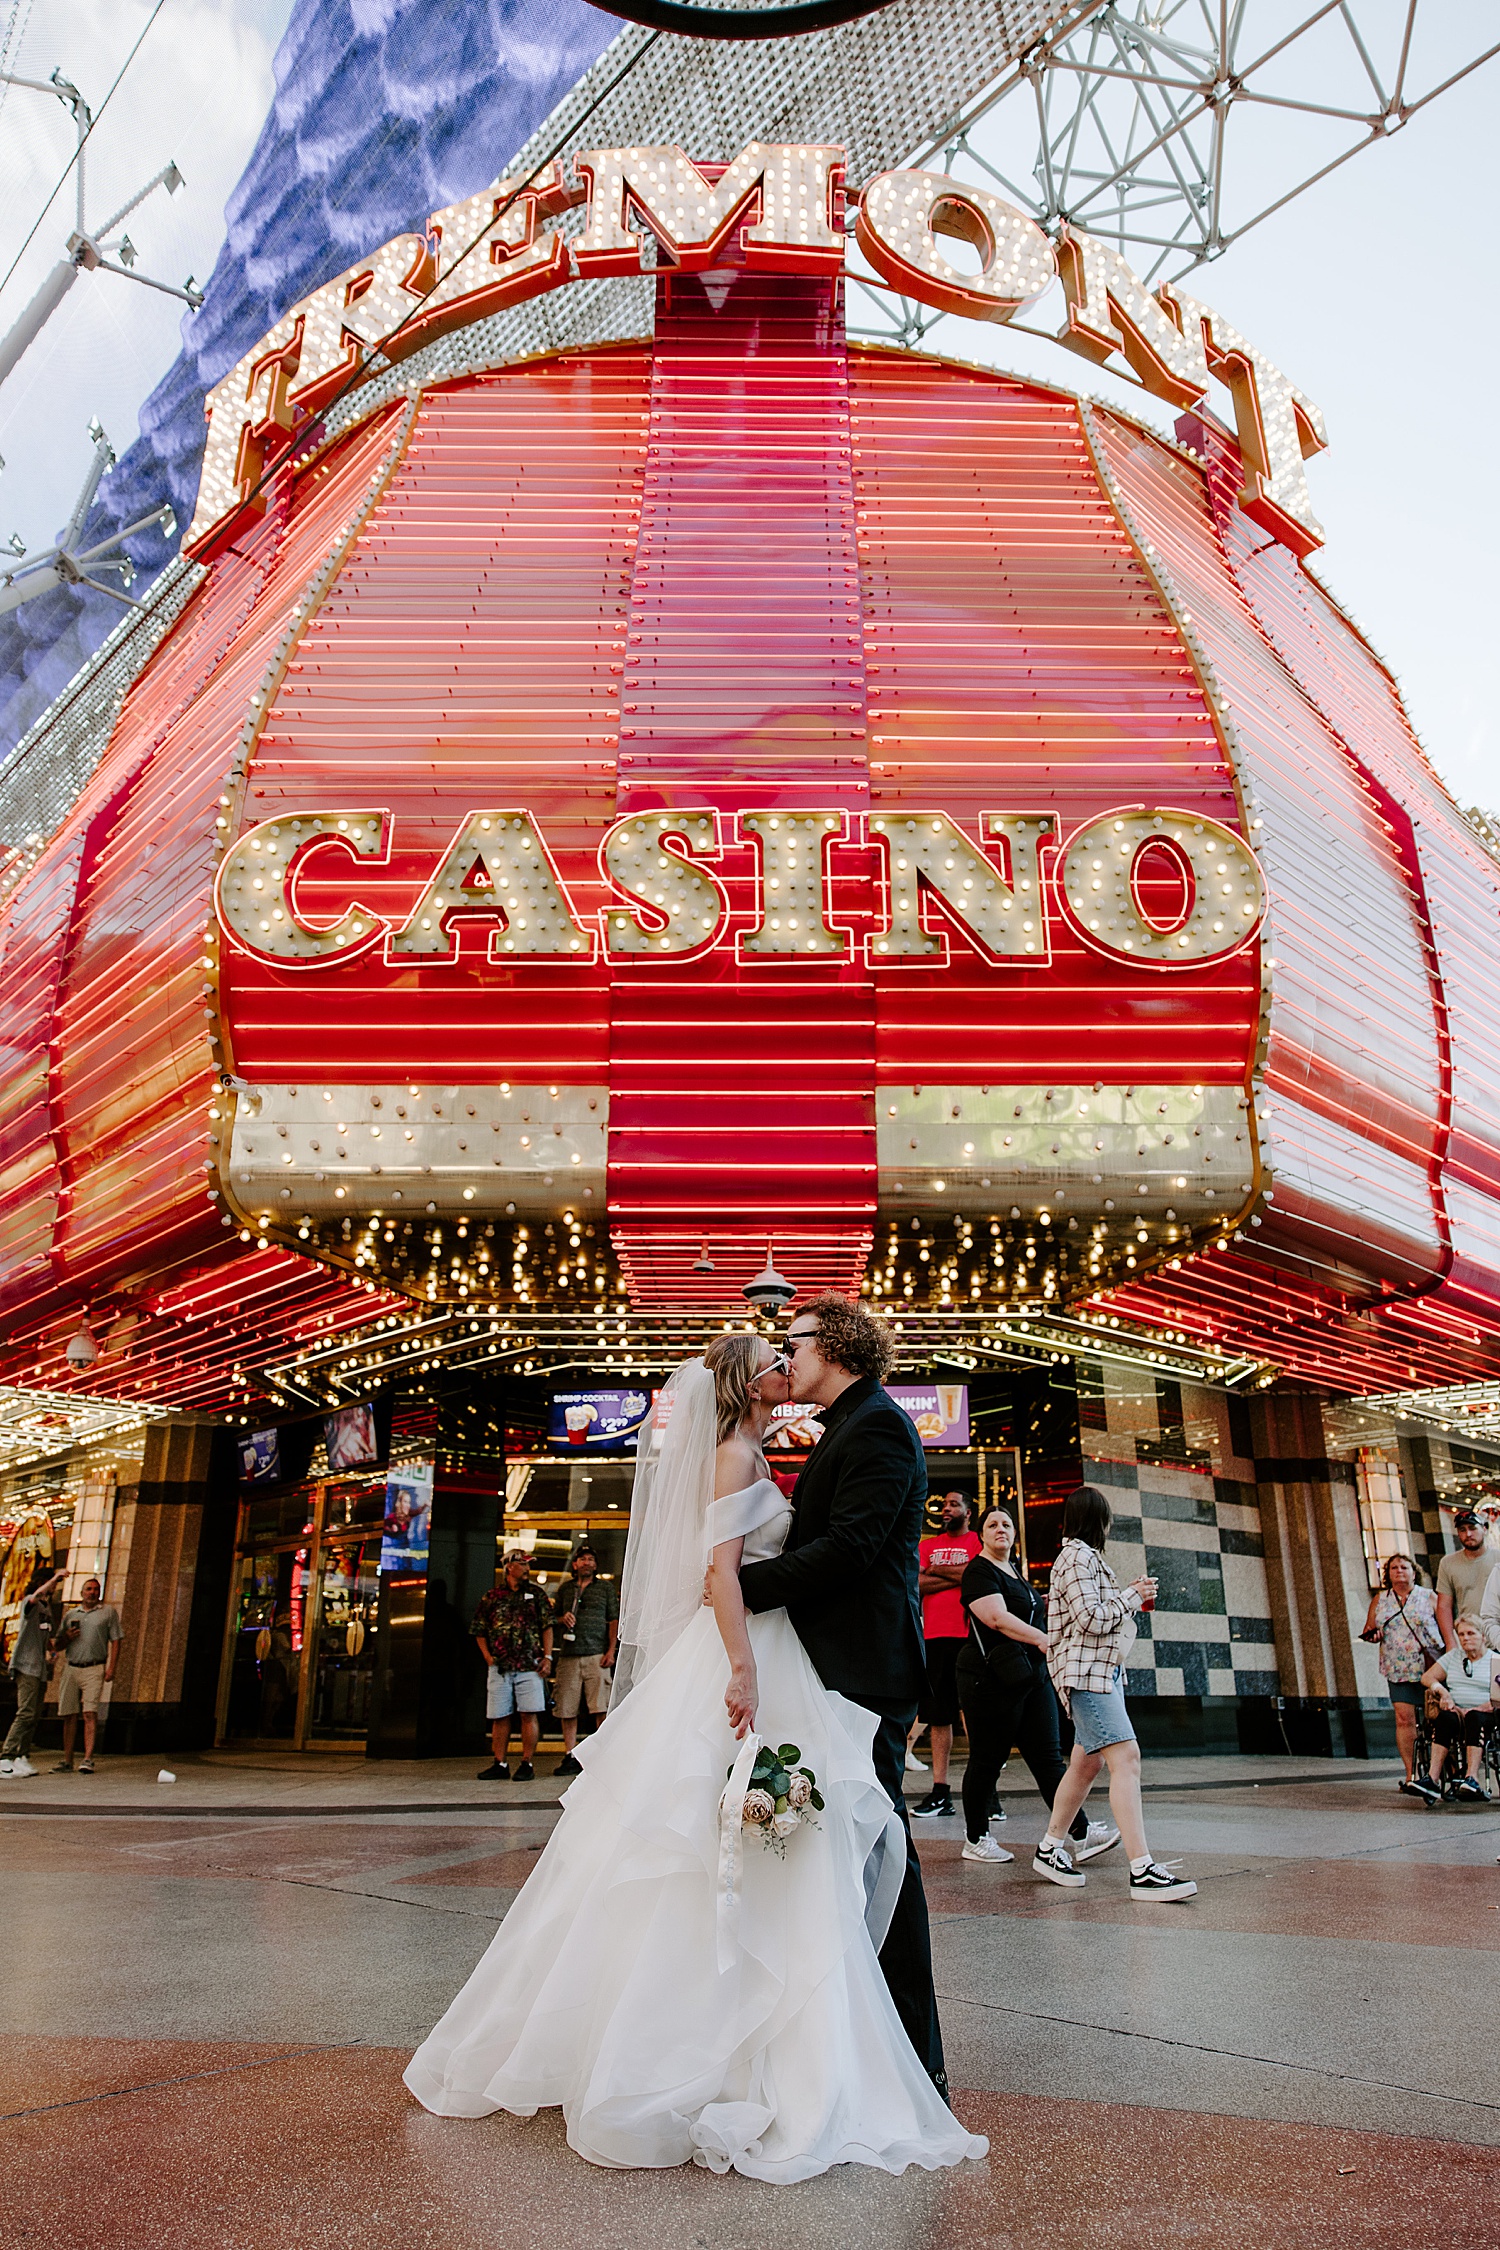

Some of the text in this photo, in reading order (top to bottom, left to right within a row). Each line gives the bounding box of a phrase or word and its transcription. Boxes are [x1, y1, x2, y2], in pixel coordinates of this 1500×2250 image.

[182, 142, 1329, 559] FREMONT
[214, 804, 1269, 972] CASINO
[582, 1394, 620, 1402] COCKTAIL
[893, 1396, 937, 1410] NKIN'
